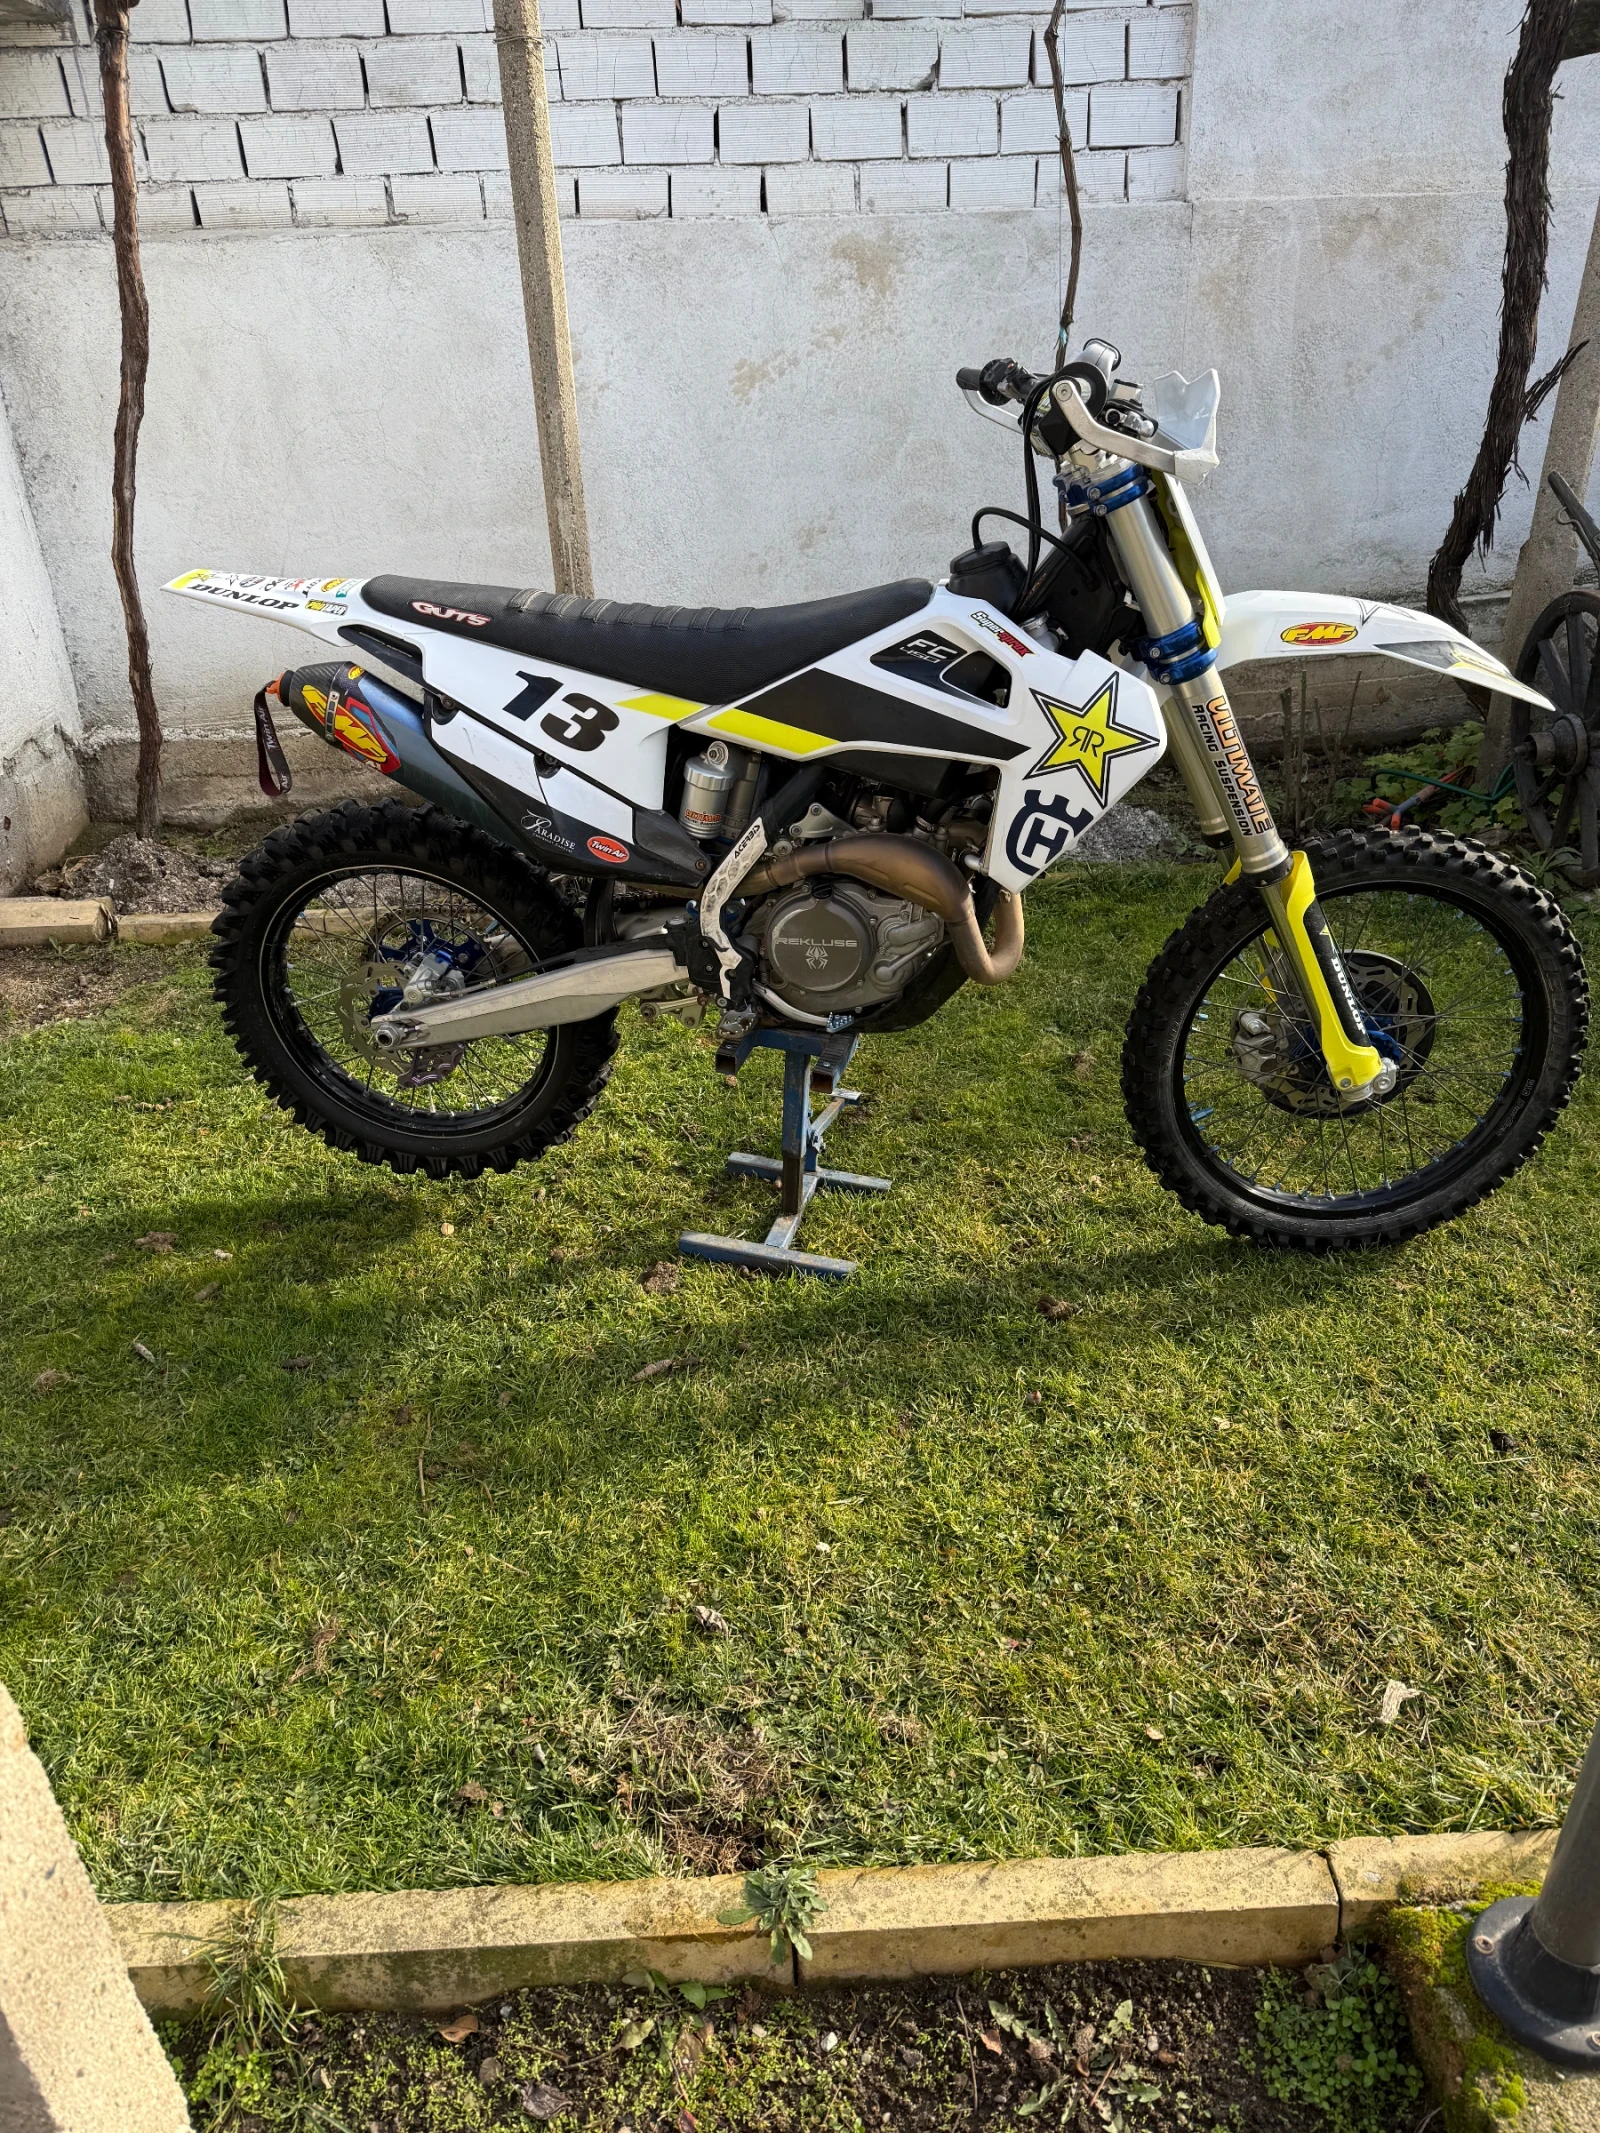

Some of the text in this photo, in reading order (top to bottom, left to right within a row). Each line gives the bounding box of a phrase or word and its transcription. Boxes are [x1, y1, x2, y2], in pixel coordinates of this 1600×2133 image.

[188, 583, 299, 610] DUNLOP
[411, 601, 492, 627] GUTS
[1282, 625, 1356, 642] FMF
[900, 646, 940, 663] 450
[907, 639, 958, 660] FC
[502, 671, 620, 752] 13
[258, 706, 276, 749] Twin Air
[1192, 704, 1253, 836] RACING SUSPENSION
[1206, 694, 1274, 835] ULTIMATE
[592, 840, 627, 860] Twin Air
[734, 824, 761, 859] ACERBIS
[776, 937, 858, 948] REKLUSE
[1331, 957, 1366, 1034] DUNLOP
